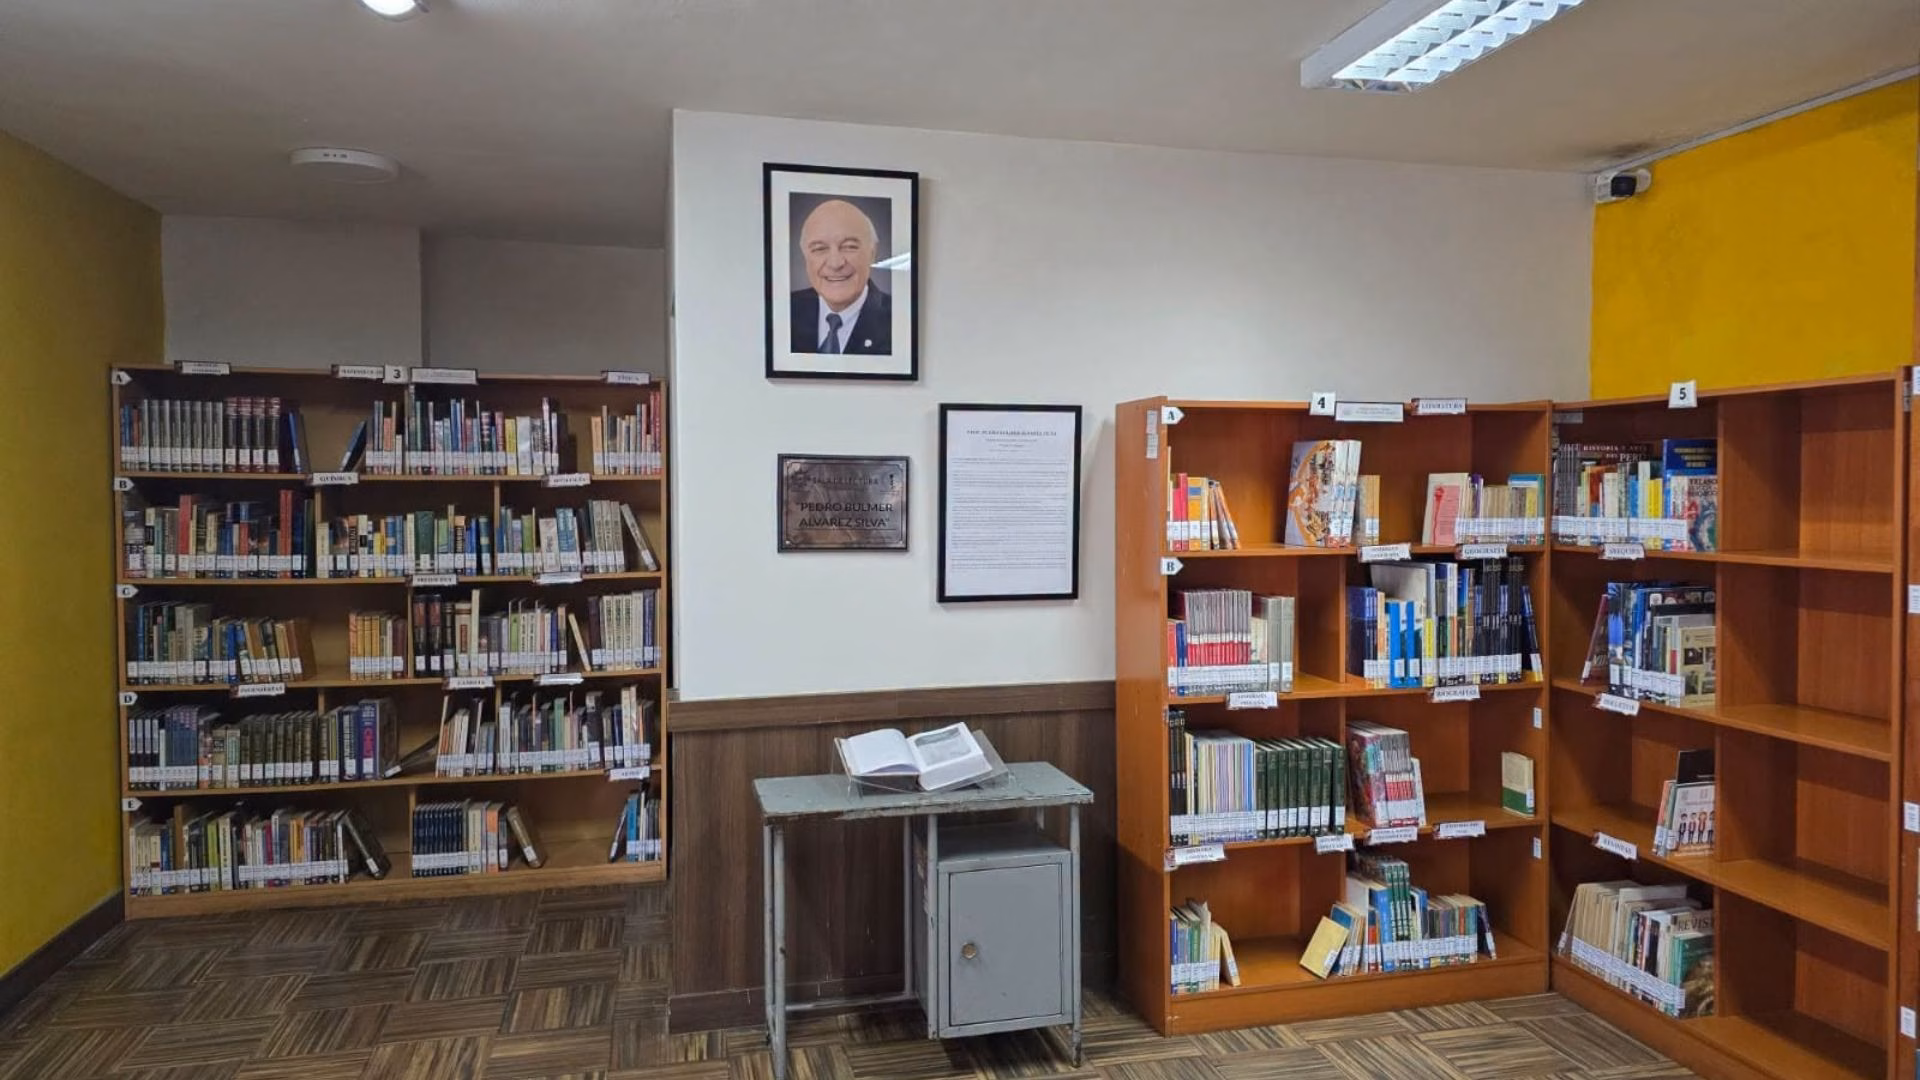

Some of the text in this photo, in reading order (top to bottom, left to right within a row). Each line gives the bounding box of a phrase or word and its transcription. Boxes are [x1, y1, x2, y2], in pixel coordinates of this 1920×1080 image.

[115, 372, 122, 382] A
[393, 369, 401, 379] 3
[1679, 387, 1687, 400] 5
[1317, 396, 1326, 409] 4
[1167, 410, 1175, 421] A
[119, 480, 127, 488] B
[796, 502, 894, 512] "PEDRO BULMER
[799, 517, 890, 528] ALVAREZ SILVA"
[1166, 561, 1175, 572] B
[121, 587, 130, 596] C
[124, 695, 132, 704] D
[127, 801, 134, 809] E
